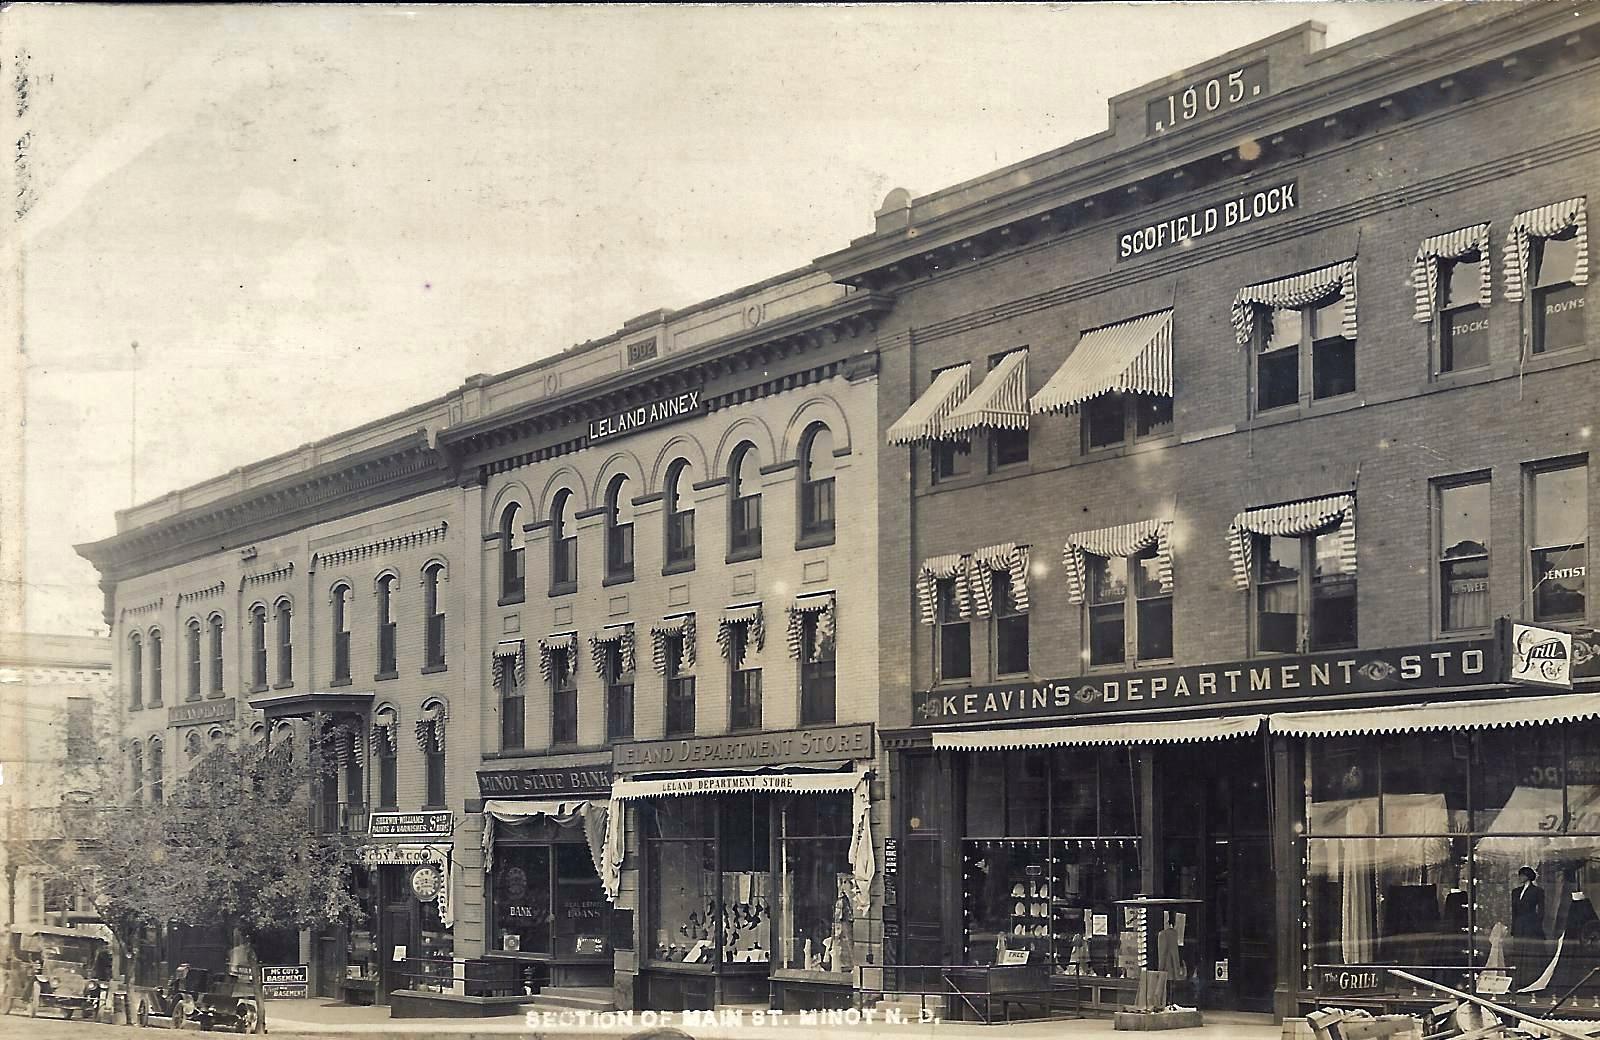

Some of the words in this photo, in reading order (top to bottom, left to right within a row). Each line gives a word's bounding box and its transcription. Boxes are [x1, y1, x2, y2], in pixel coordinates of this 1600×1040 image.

[1121, 207, 1218, 257] SCOFIELD
[1225, 183, 1295, 227] BLOCK
[590, 407, 646, 439] LELAND
[650, 391, 699, 421] ANNEX
[1517, 629, 1567, 674] Grill
[943, 684, 1070, 716] KEAVIN'S
[1103, 660, 1356, 703] DEPARTMENT
[617, 746, 673, 766] LELAND
[678, 740, 792, 762] DEPARTMENT
[481, 774, 519, 791] MINOT
[524, 773, 565, 790] STATE
[569, 771, 610, 788] BANK
[662, 780, 692, 791] LELAND
[699, 777, 756, 790] DEPARTMENT
[763, 777, 793, 788] STORE
[510, 906, 532, 917] BANK
[1339, 971, 1378, 989] GRILL
